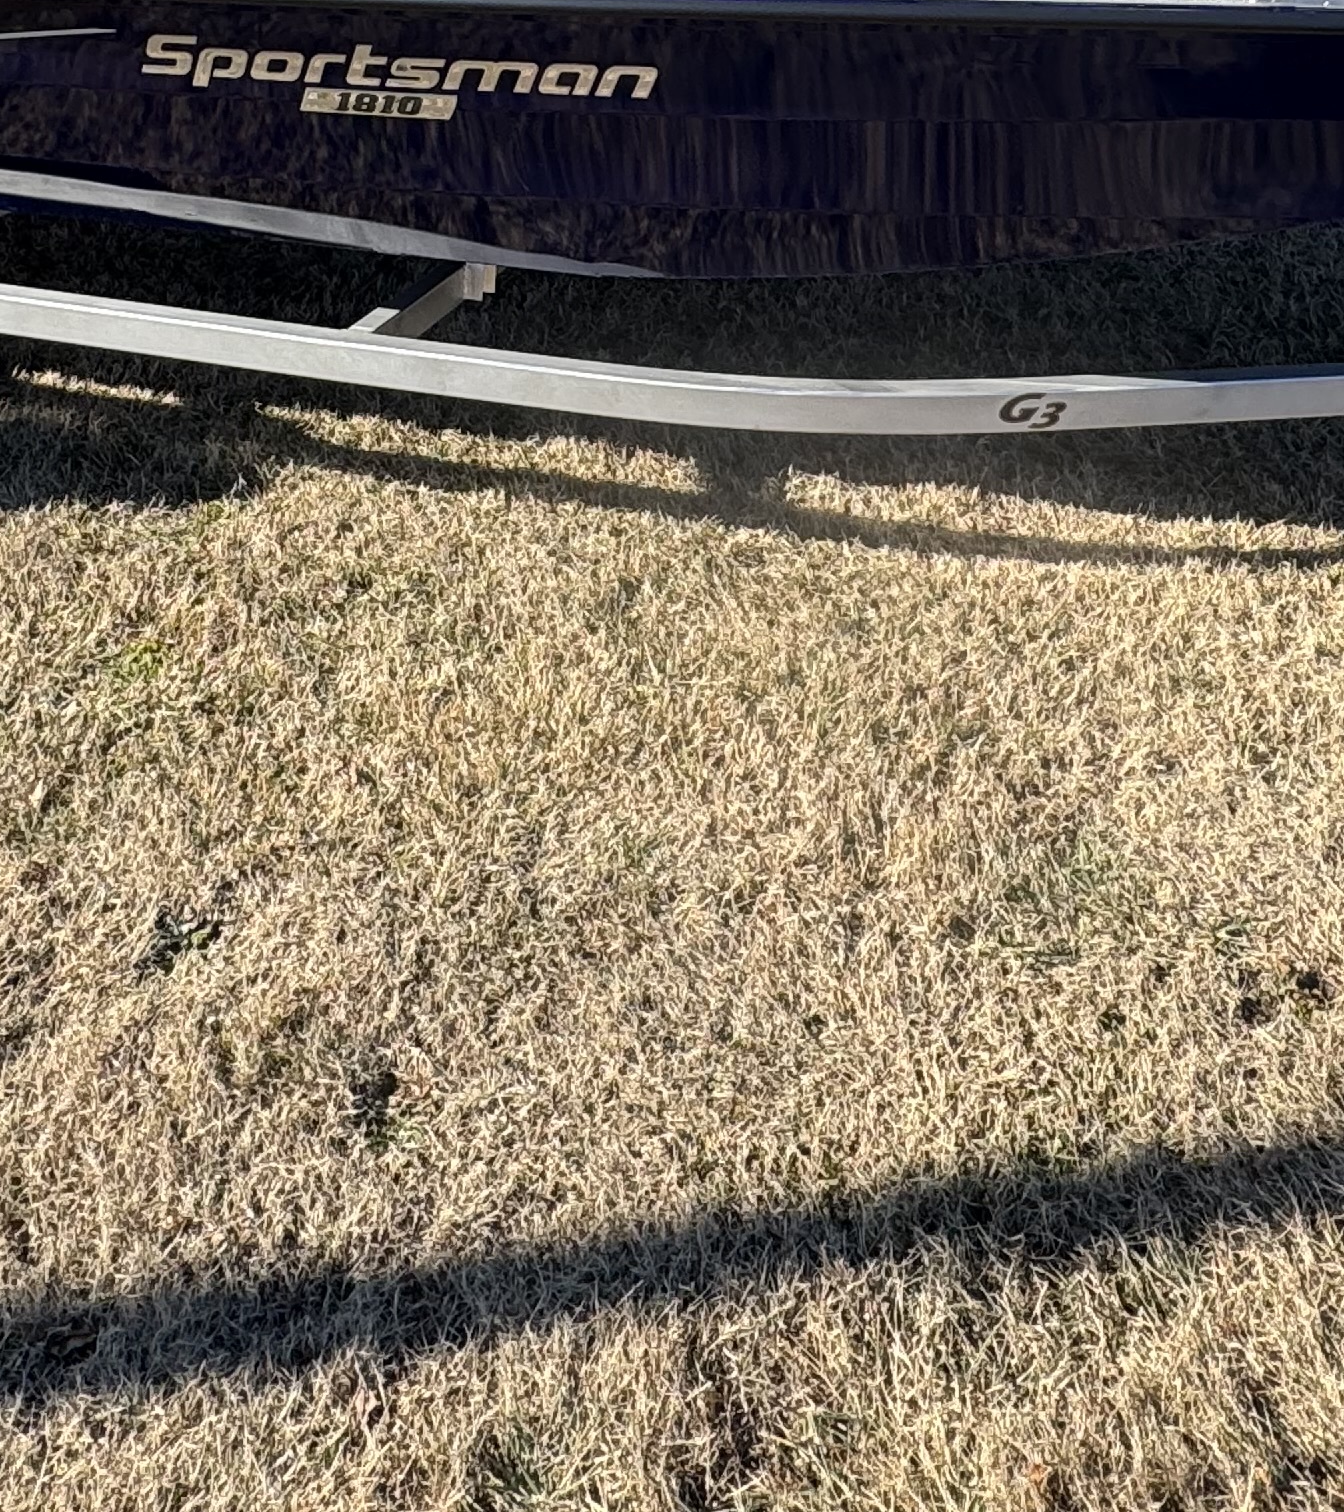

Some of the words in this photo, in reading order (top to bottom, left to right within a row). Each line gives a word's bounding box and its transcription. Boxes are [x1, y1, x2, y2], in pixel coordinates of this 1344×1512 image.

[142, 34, 659, 99] Sportsman
[335, 92, 423, 116] 1810
[999, 392, 1067, 429] G3
